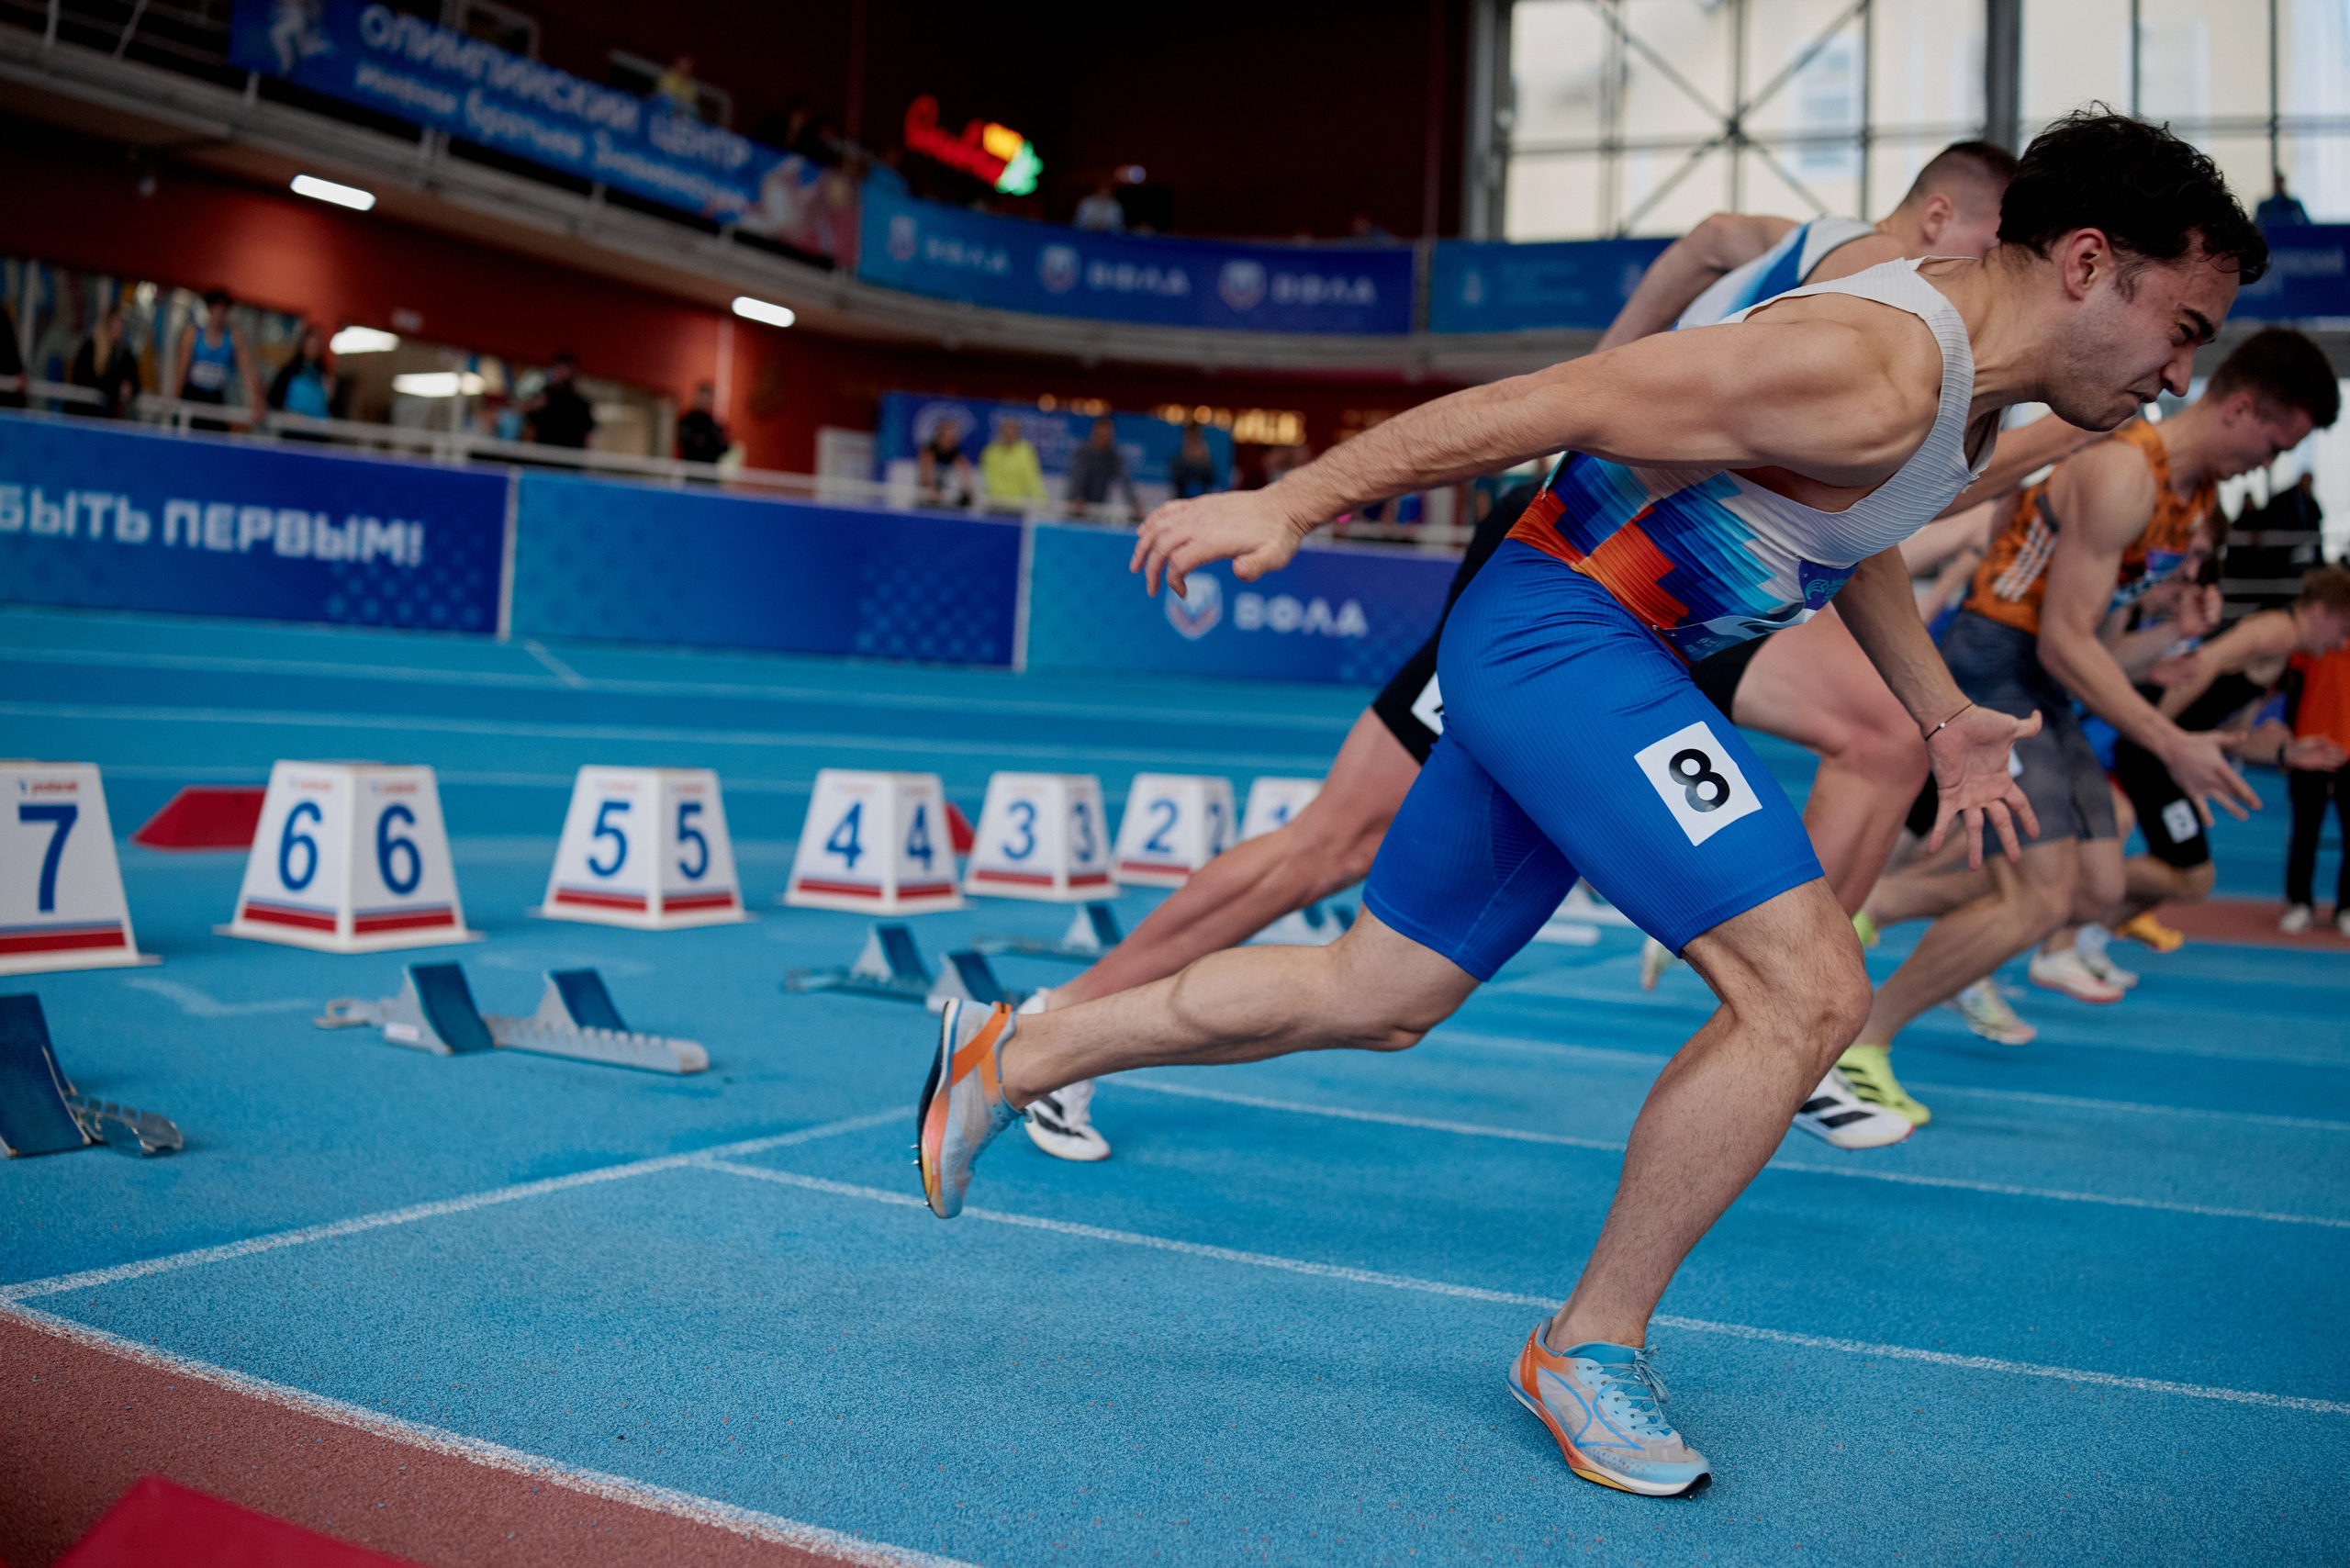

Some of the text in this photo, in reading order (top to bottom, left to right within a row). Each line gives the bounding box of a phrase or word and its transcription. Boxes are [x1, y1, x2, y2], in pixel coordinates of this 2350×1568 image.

[0, 484, 425, 566] БЫТЬ ПЕРВЫМ!
[1234, 592, 1370, 638] ВФЛА
[1669, 748, 1730, 812] 8
[18, 805, 78, 912] 7
[279, 801, 322, 890] 6
[376, 804, 422, 895] 6
[588, 801, 632, 878] 5
[677, 803, 709, 879] 5
[825, 801, 864, 869] 4
[907, 803, 933, 870] 4
[1002, 800, 1036, 861] 3
[1073, 802, 1095, 864] 3
[1144, 799, 1179, 855] 2
